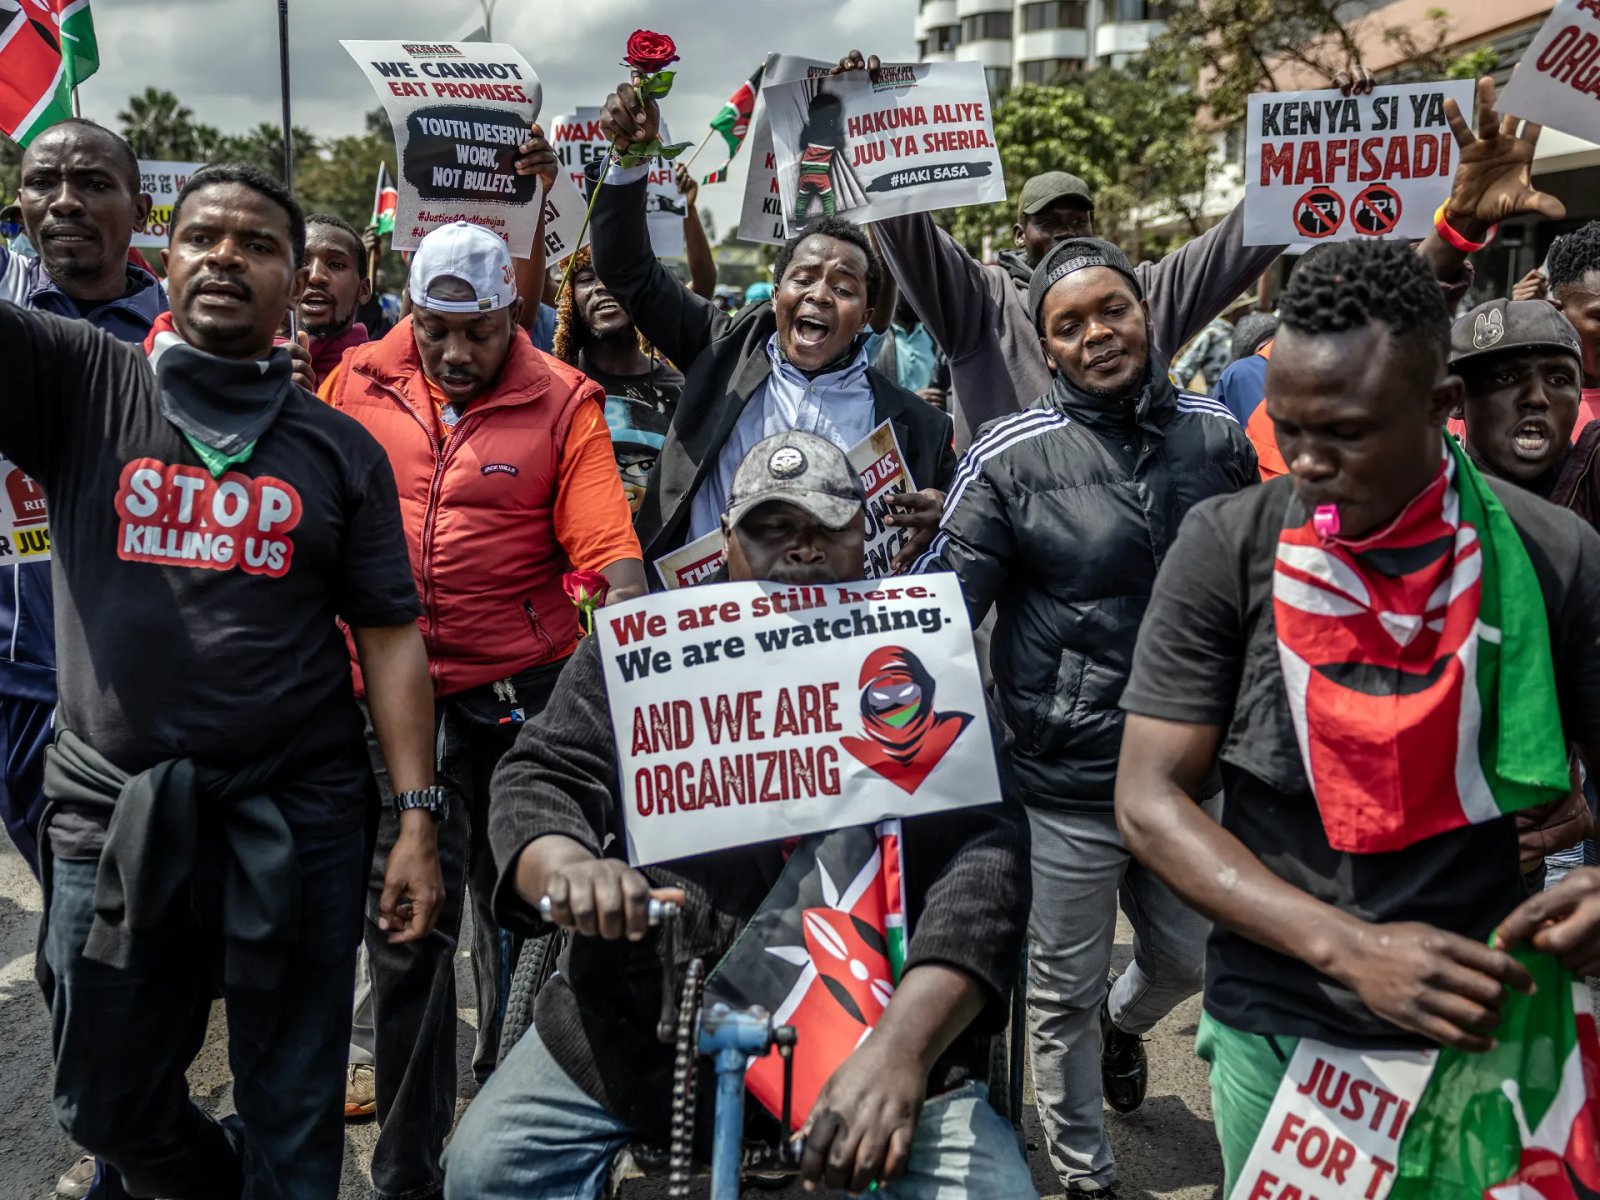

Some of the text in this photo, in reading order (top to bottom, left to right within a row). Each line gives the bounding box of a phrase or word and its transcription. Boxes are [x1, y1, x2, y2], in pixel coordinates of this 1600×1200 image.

[370, 61, 523, 80] WE CANNOT
[1536, 25, 1600, 101] ORG
[388, 81, 533, 104] EAT PROMISES.
[416, 117, 532, 146] YOUTH DESERVE
[848, 102, 985, 138] HAKUNA ALIYE
[1261, 92, 1447, 137] KENYA SI YA
[455, 143, 499, 170] WORK,
[852, 129, 995, 168] JUU YA SHERIA.
[1260, 132, 1451, 187] MAFISADI
[161, 184, 172, 194] IS
[432, 167, 516, 194] NOT BULLETS.
[890, 165, 969, 187] #HAKI SASA
[876, 453, 899, 480] US.
[123, 523, 287, 570] KILLING US
[610, 585, 937, 648] We are still here.
[616, 606, 952, 683] We are watching.
[631, 682, 842, 757] AND WE ARE
[634, 745, 841, 817] ORGANIZING
[1272, 1112, 1356, 1185] FOR
